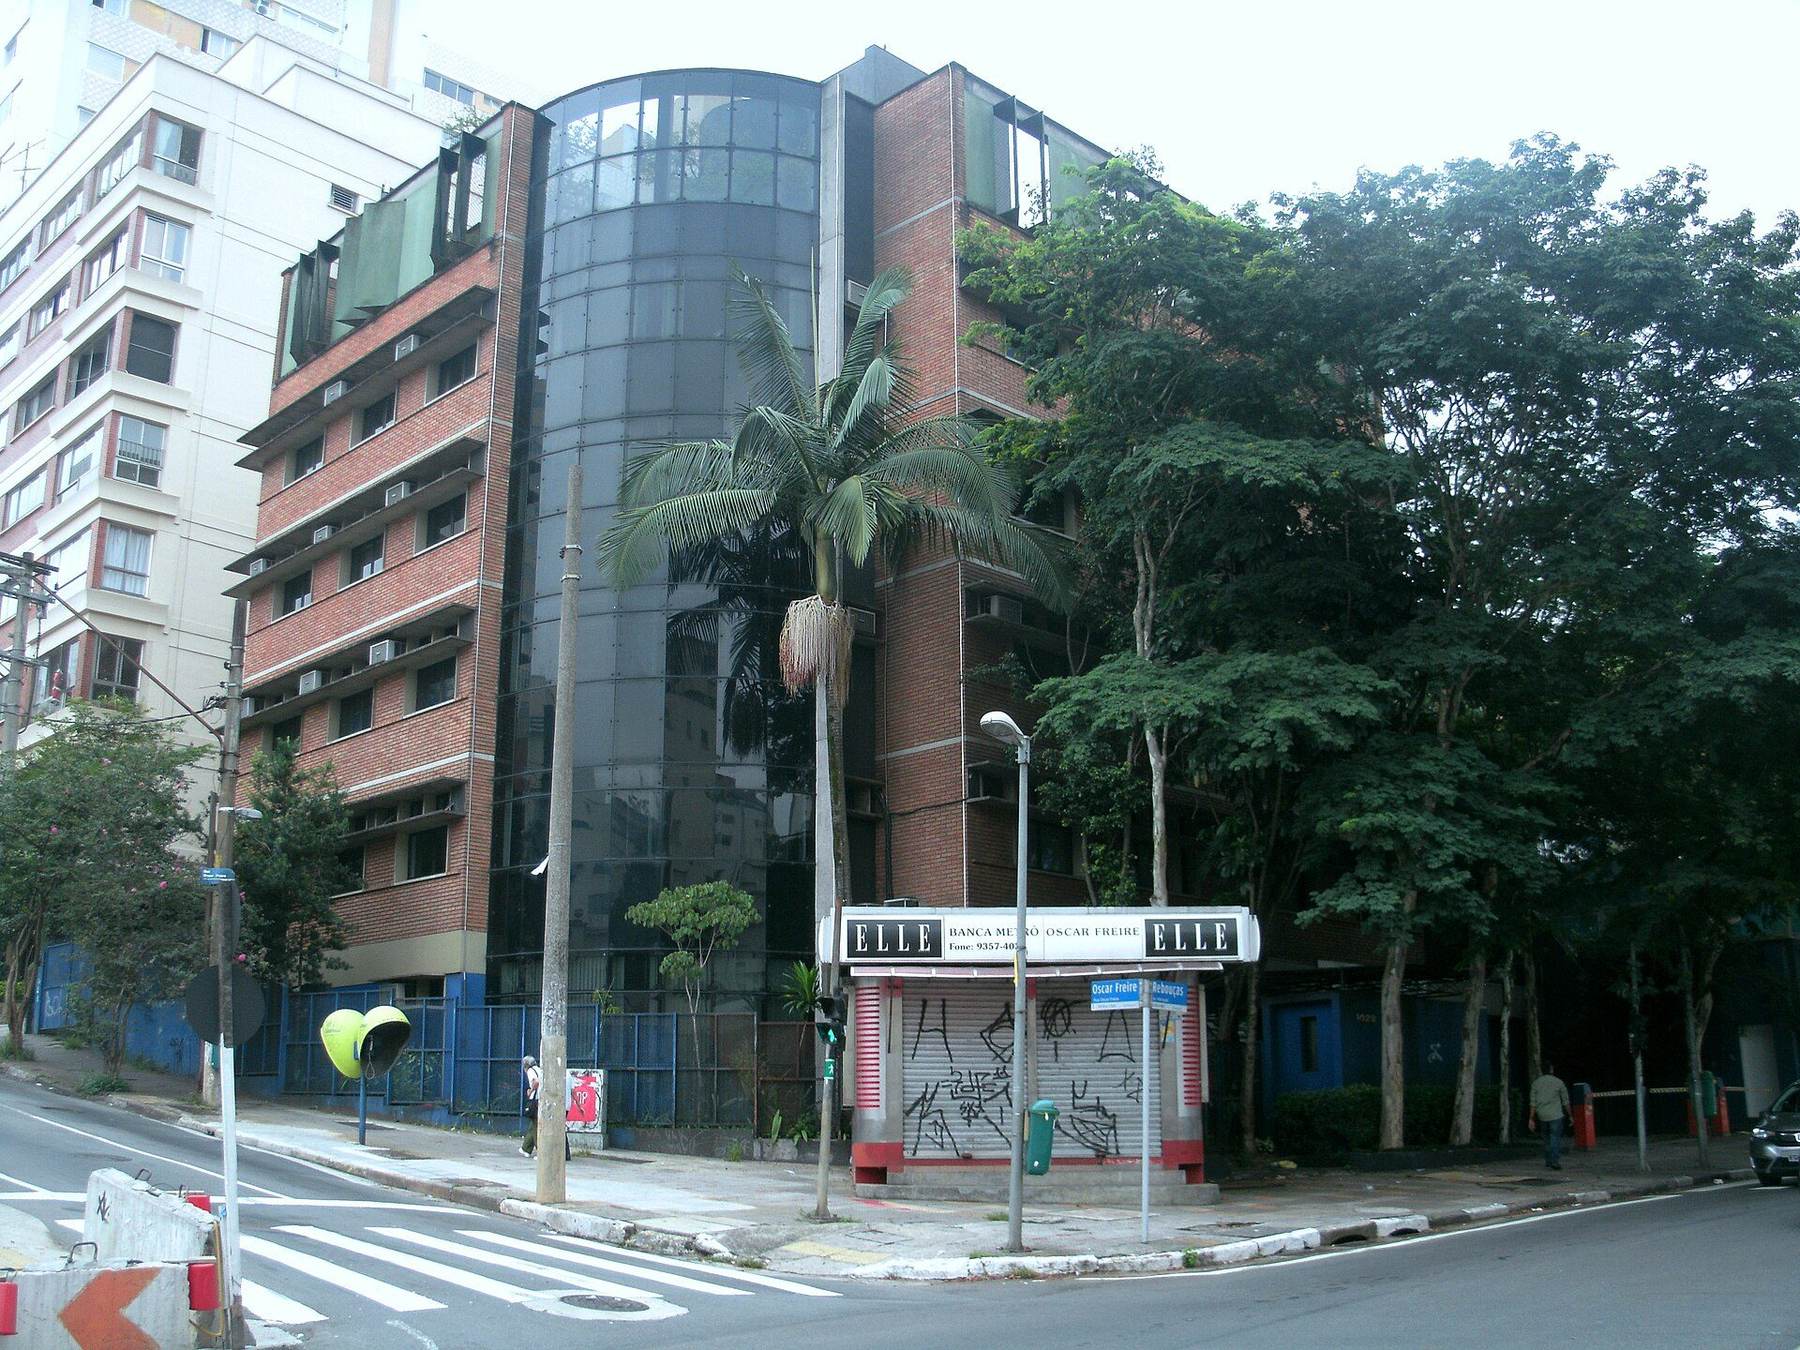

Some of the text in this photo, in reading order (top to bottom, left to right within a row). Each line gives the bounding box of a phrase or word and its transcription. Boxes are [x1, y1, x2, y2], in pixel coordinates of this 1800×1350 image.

[856, 924, 931, 952] ELLE
[949, 928, 990, 937] BANCA
[1046, 927, 1090, 936] OSCAR
[1095, 926, 1140, 936] FREIRE
[1153, 923, 1227, 951] ELLE
[949, 942, 974, 951] Fone:
[1092, 981, 1138, 994] Oscar Freire
[1152, 981, 1184, 997] Rebouças
